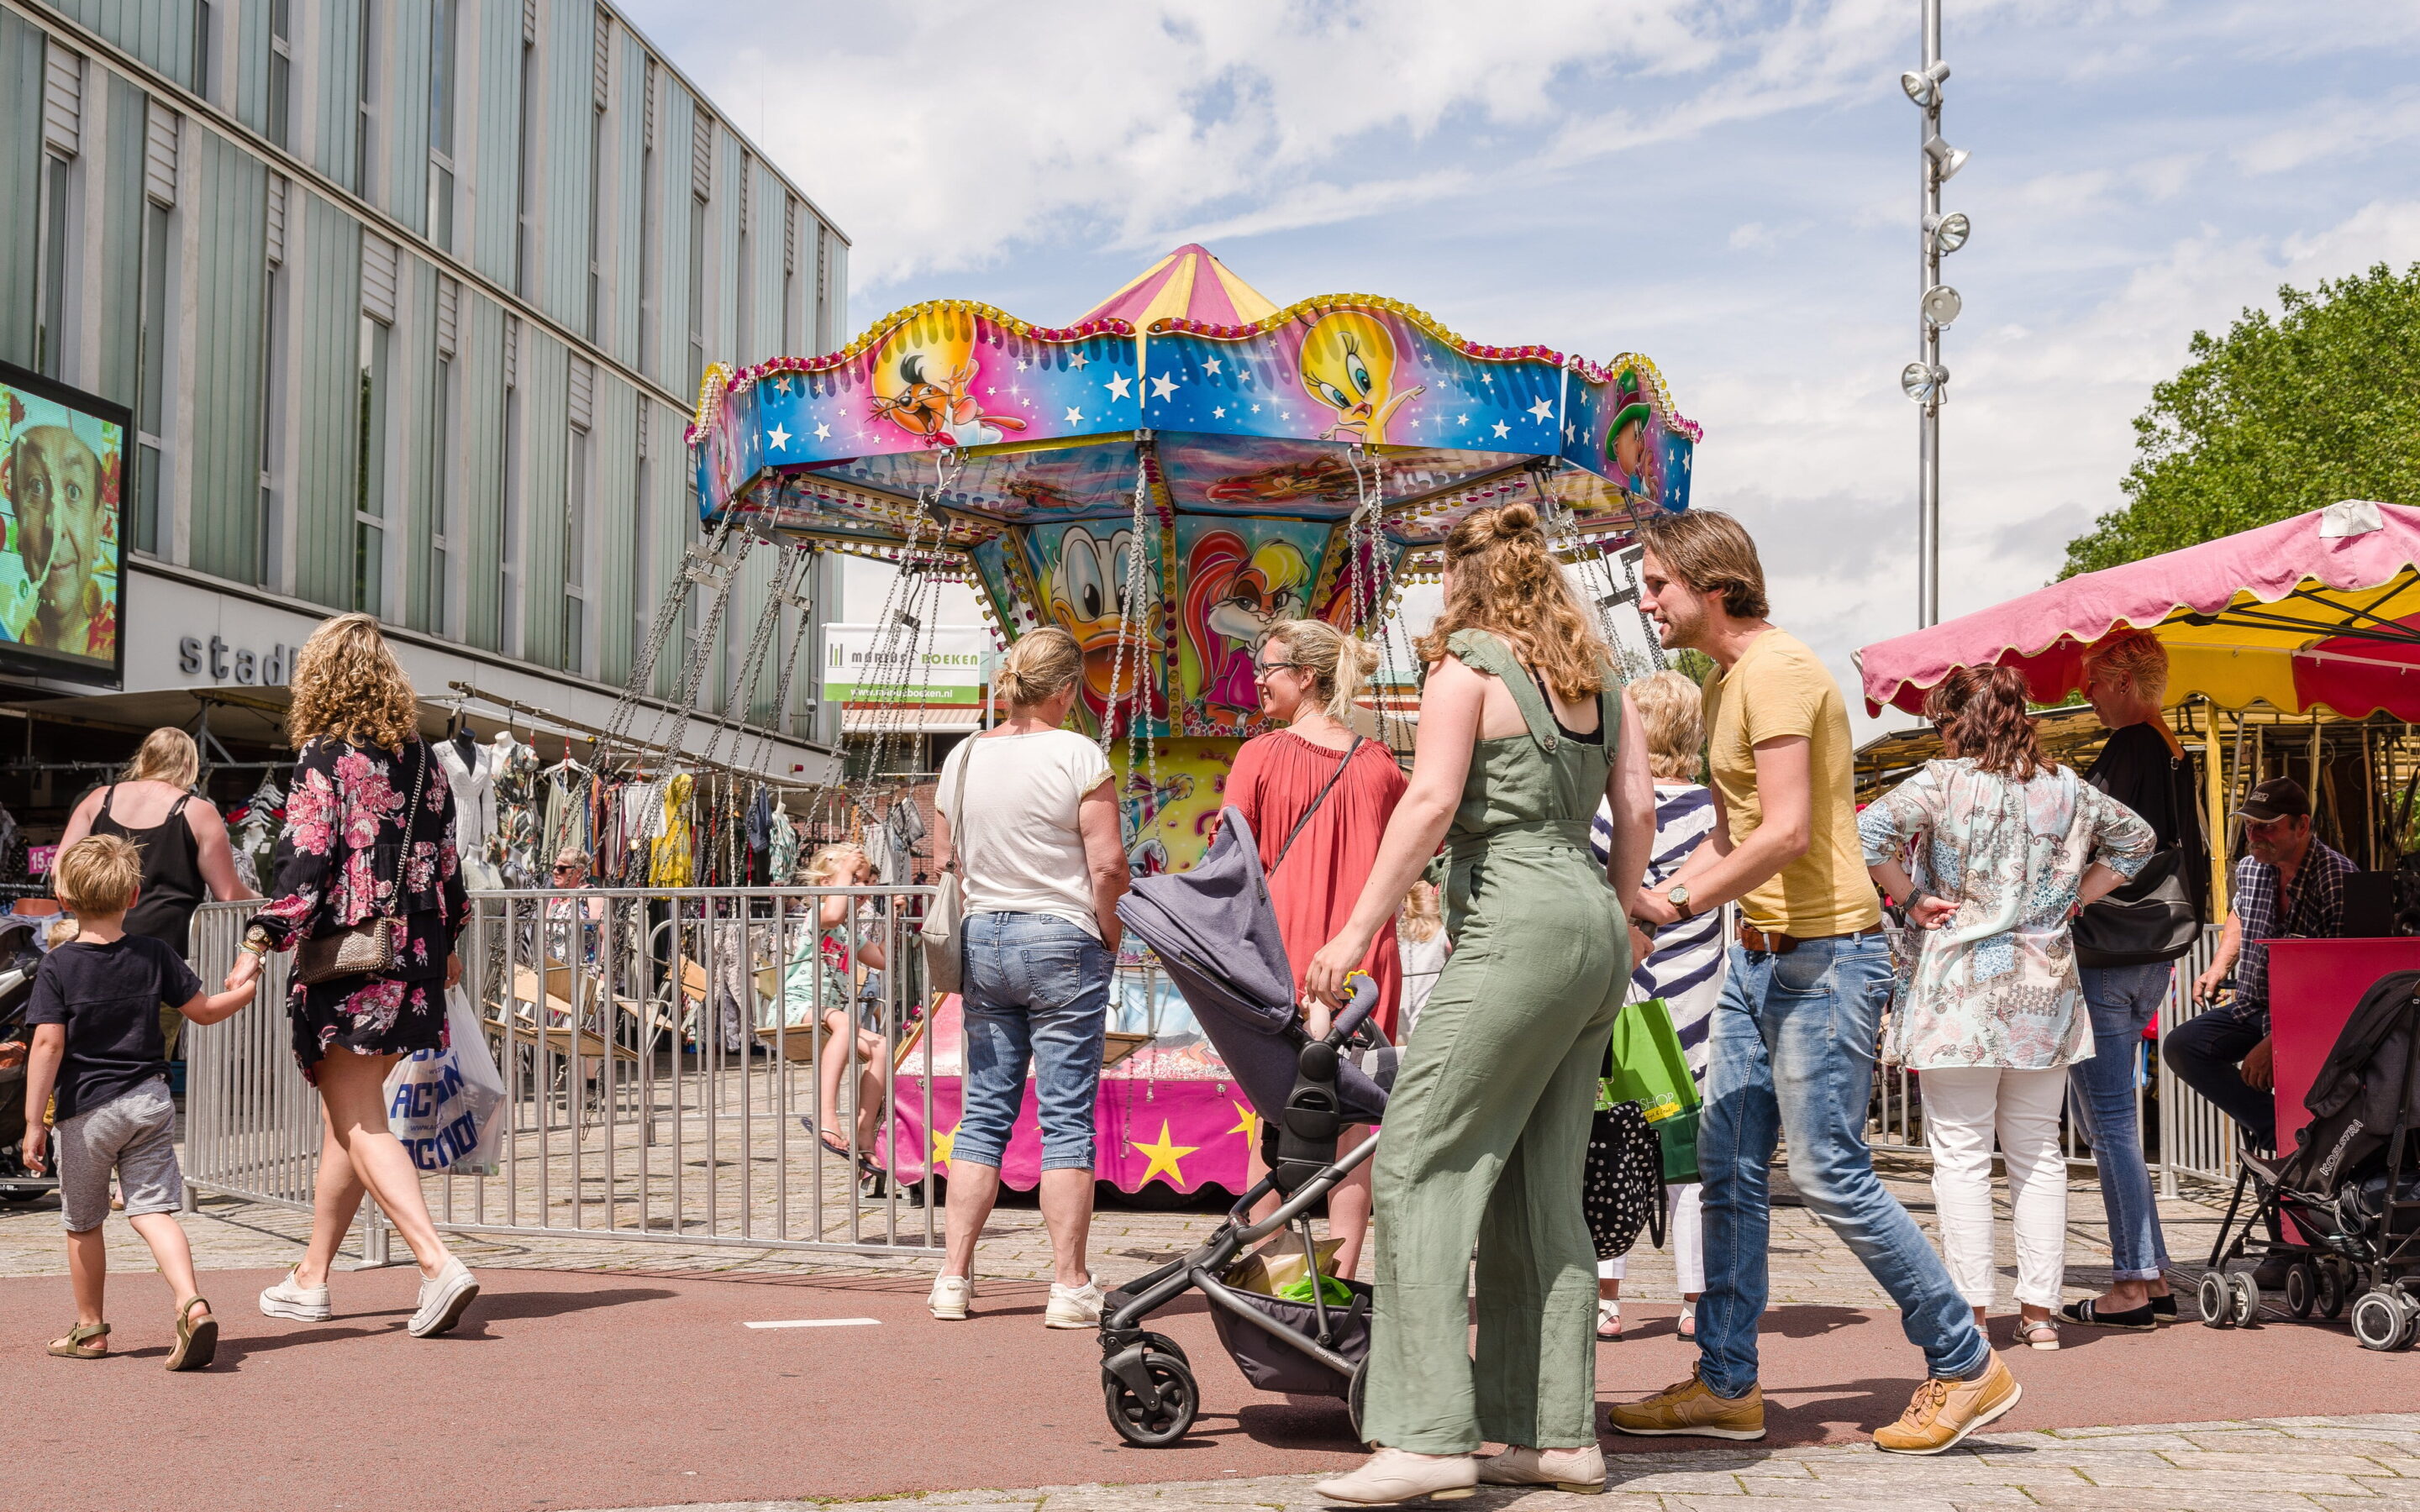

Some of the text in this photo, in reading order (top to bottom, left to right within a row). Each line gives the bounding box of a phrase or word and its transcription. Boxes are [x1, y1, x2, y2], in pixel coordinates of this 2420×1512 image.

[921, 654, 978, 665] BOEKEN
[850, 688, 953, 698] www.mariuboeken.nl
[1314, 1346, 1349, 1368] easywalker
